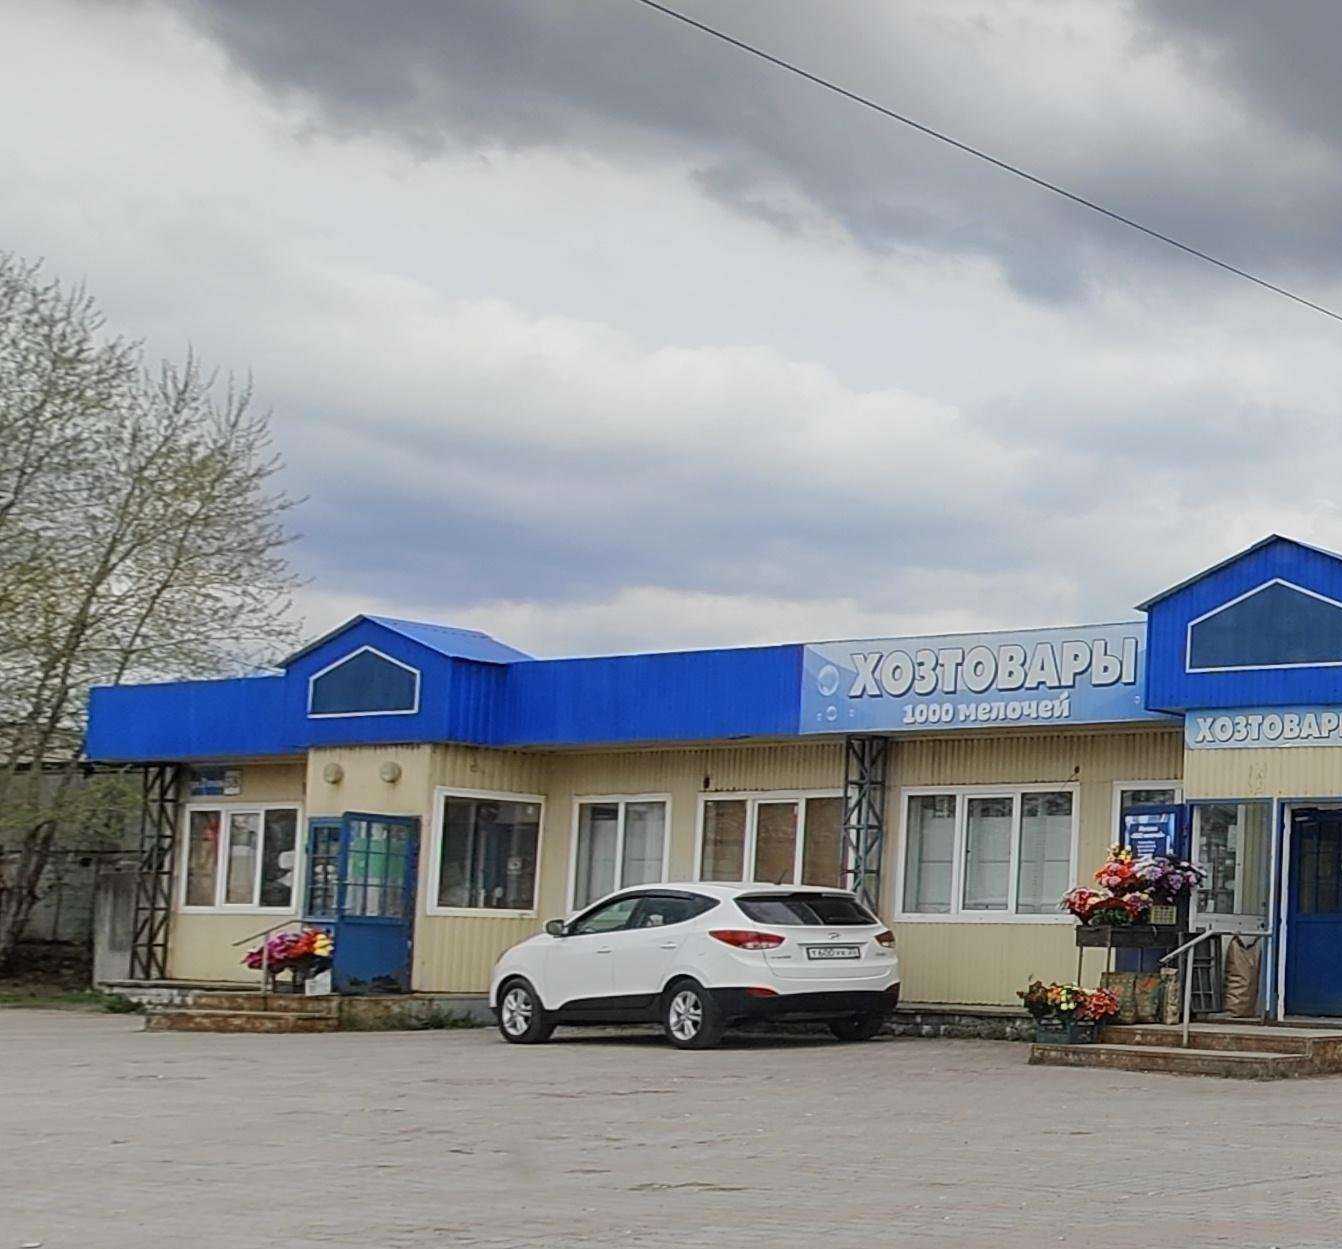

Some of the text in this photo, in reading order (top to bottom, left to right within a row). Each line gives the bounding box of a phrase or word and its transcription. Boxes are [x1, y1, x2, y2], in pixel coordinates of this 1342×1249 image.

[848, 637, 1138, 698] ХОЗТОВАРЫ
[902, 692, 1072, 725] 1000 мелочей
